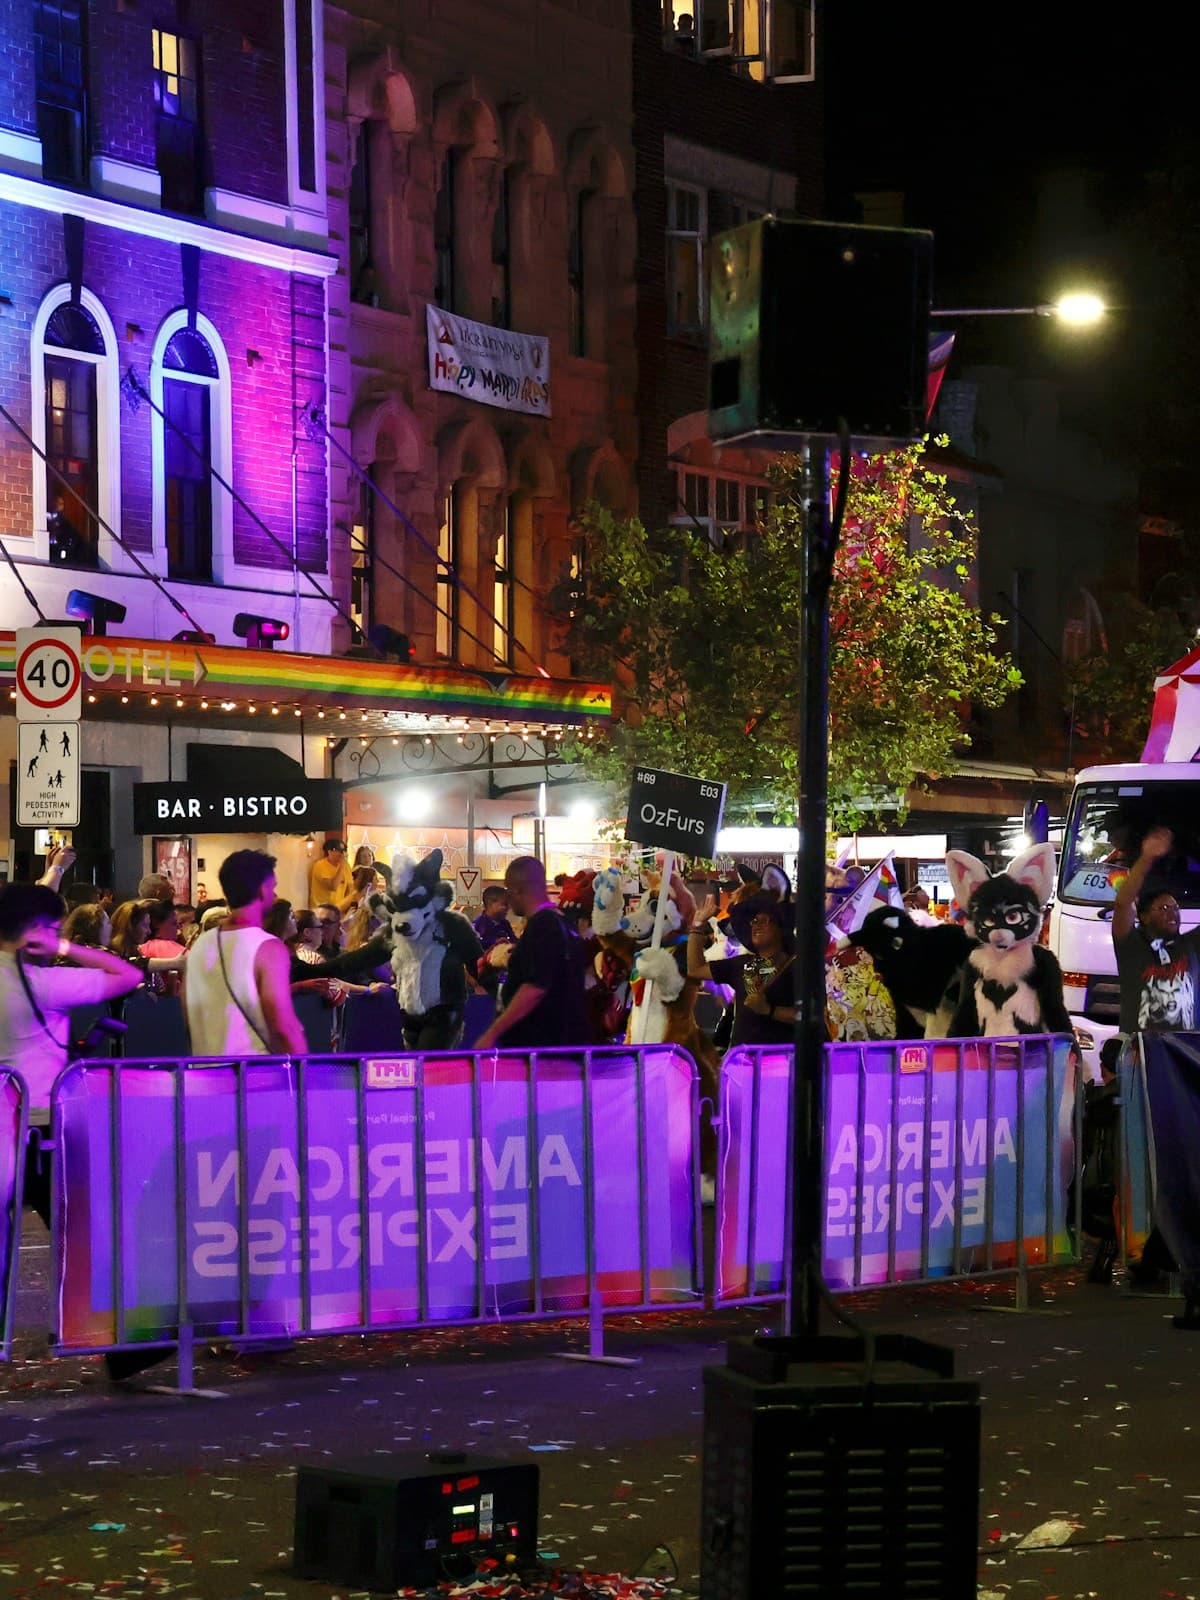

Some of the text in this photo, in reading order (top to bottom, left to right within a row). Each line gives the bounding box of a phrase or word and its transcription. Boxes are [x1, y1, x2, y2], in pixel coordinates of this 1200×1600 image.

[27, 659, 70, 688] 40
[84, 645, 181, 687] OTEL
[636, 772, 719, 799] #69 E03
[25, 801, 70, 809] PEDESTRIAN
[32, 810, 64, 818] ACTIVITY
[157, 796, 308, 819] BAR BISTRO
[640, 803, 705, 835] OzFurs
[1083, 874, 1108, 889] E03
